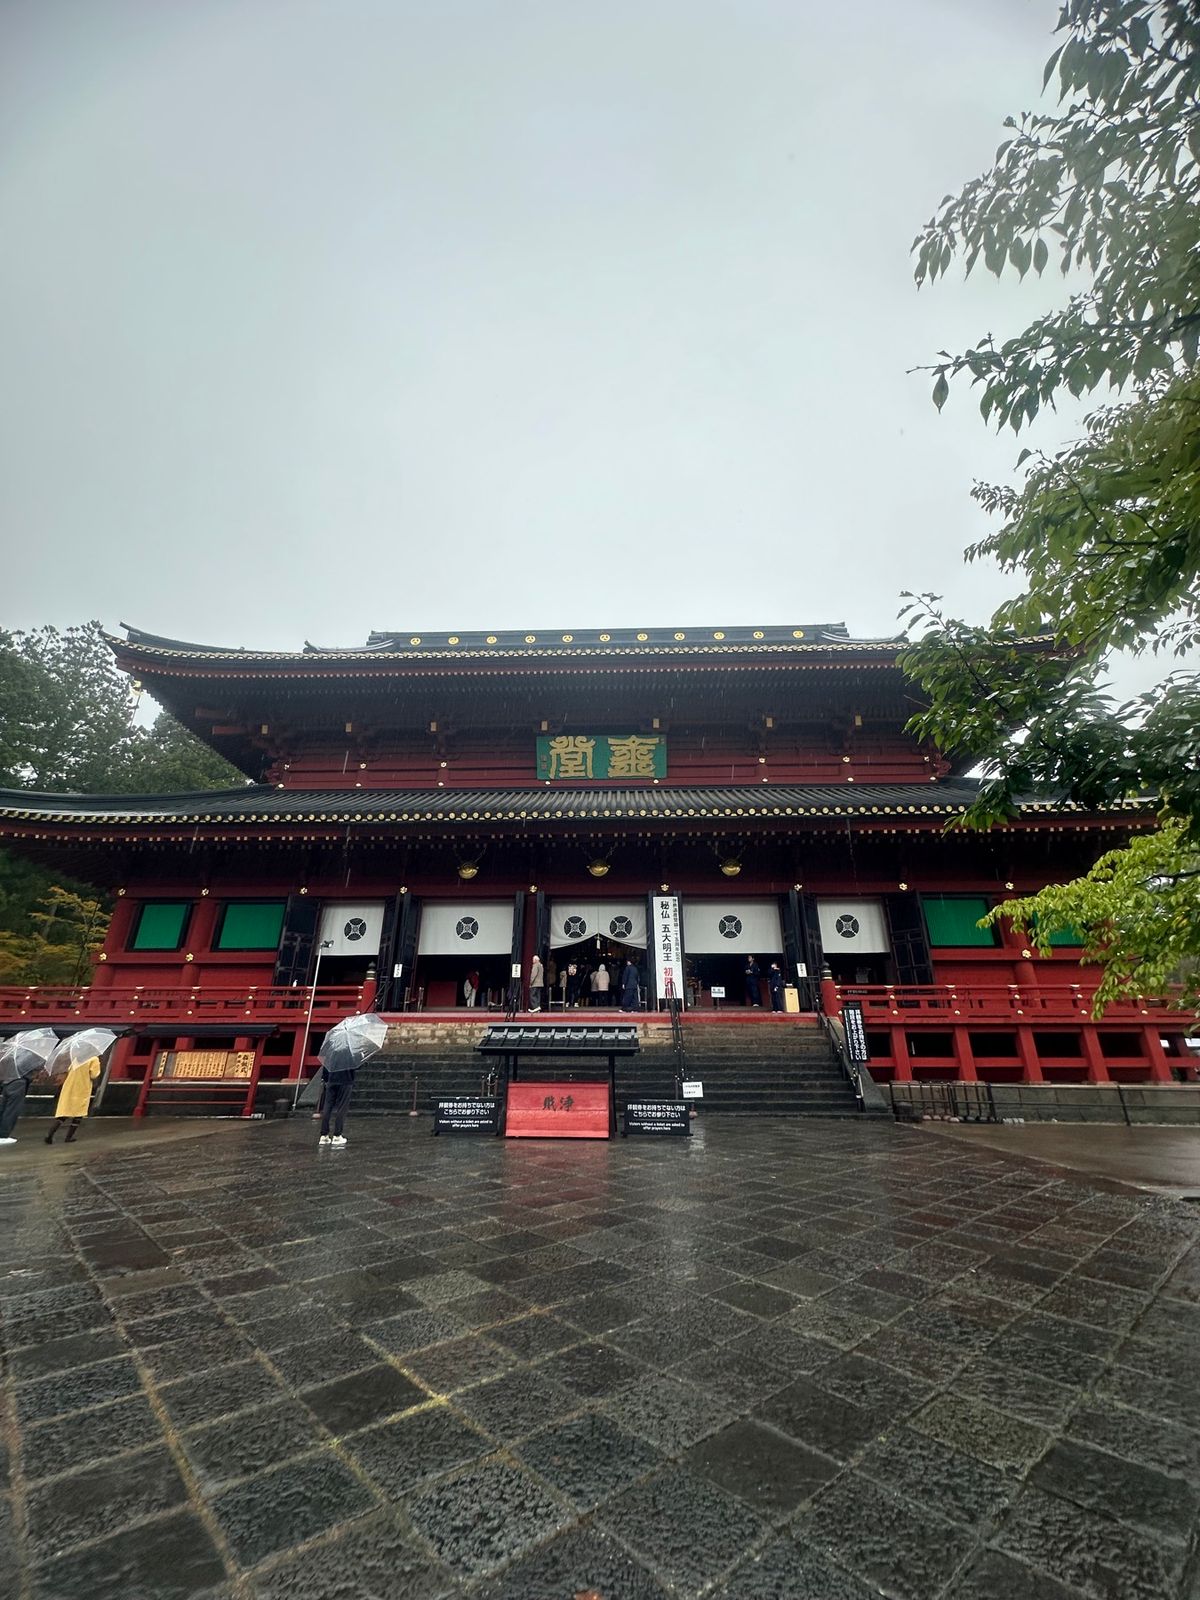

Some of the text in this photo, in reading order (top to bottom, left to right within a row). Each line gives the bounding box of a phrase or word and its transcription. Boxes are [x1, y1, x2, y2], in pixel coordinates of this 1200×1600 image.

[660, 900, 670, 918] 秘仏
[661, 924, 672, 962] 五大明王
